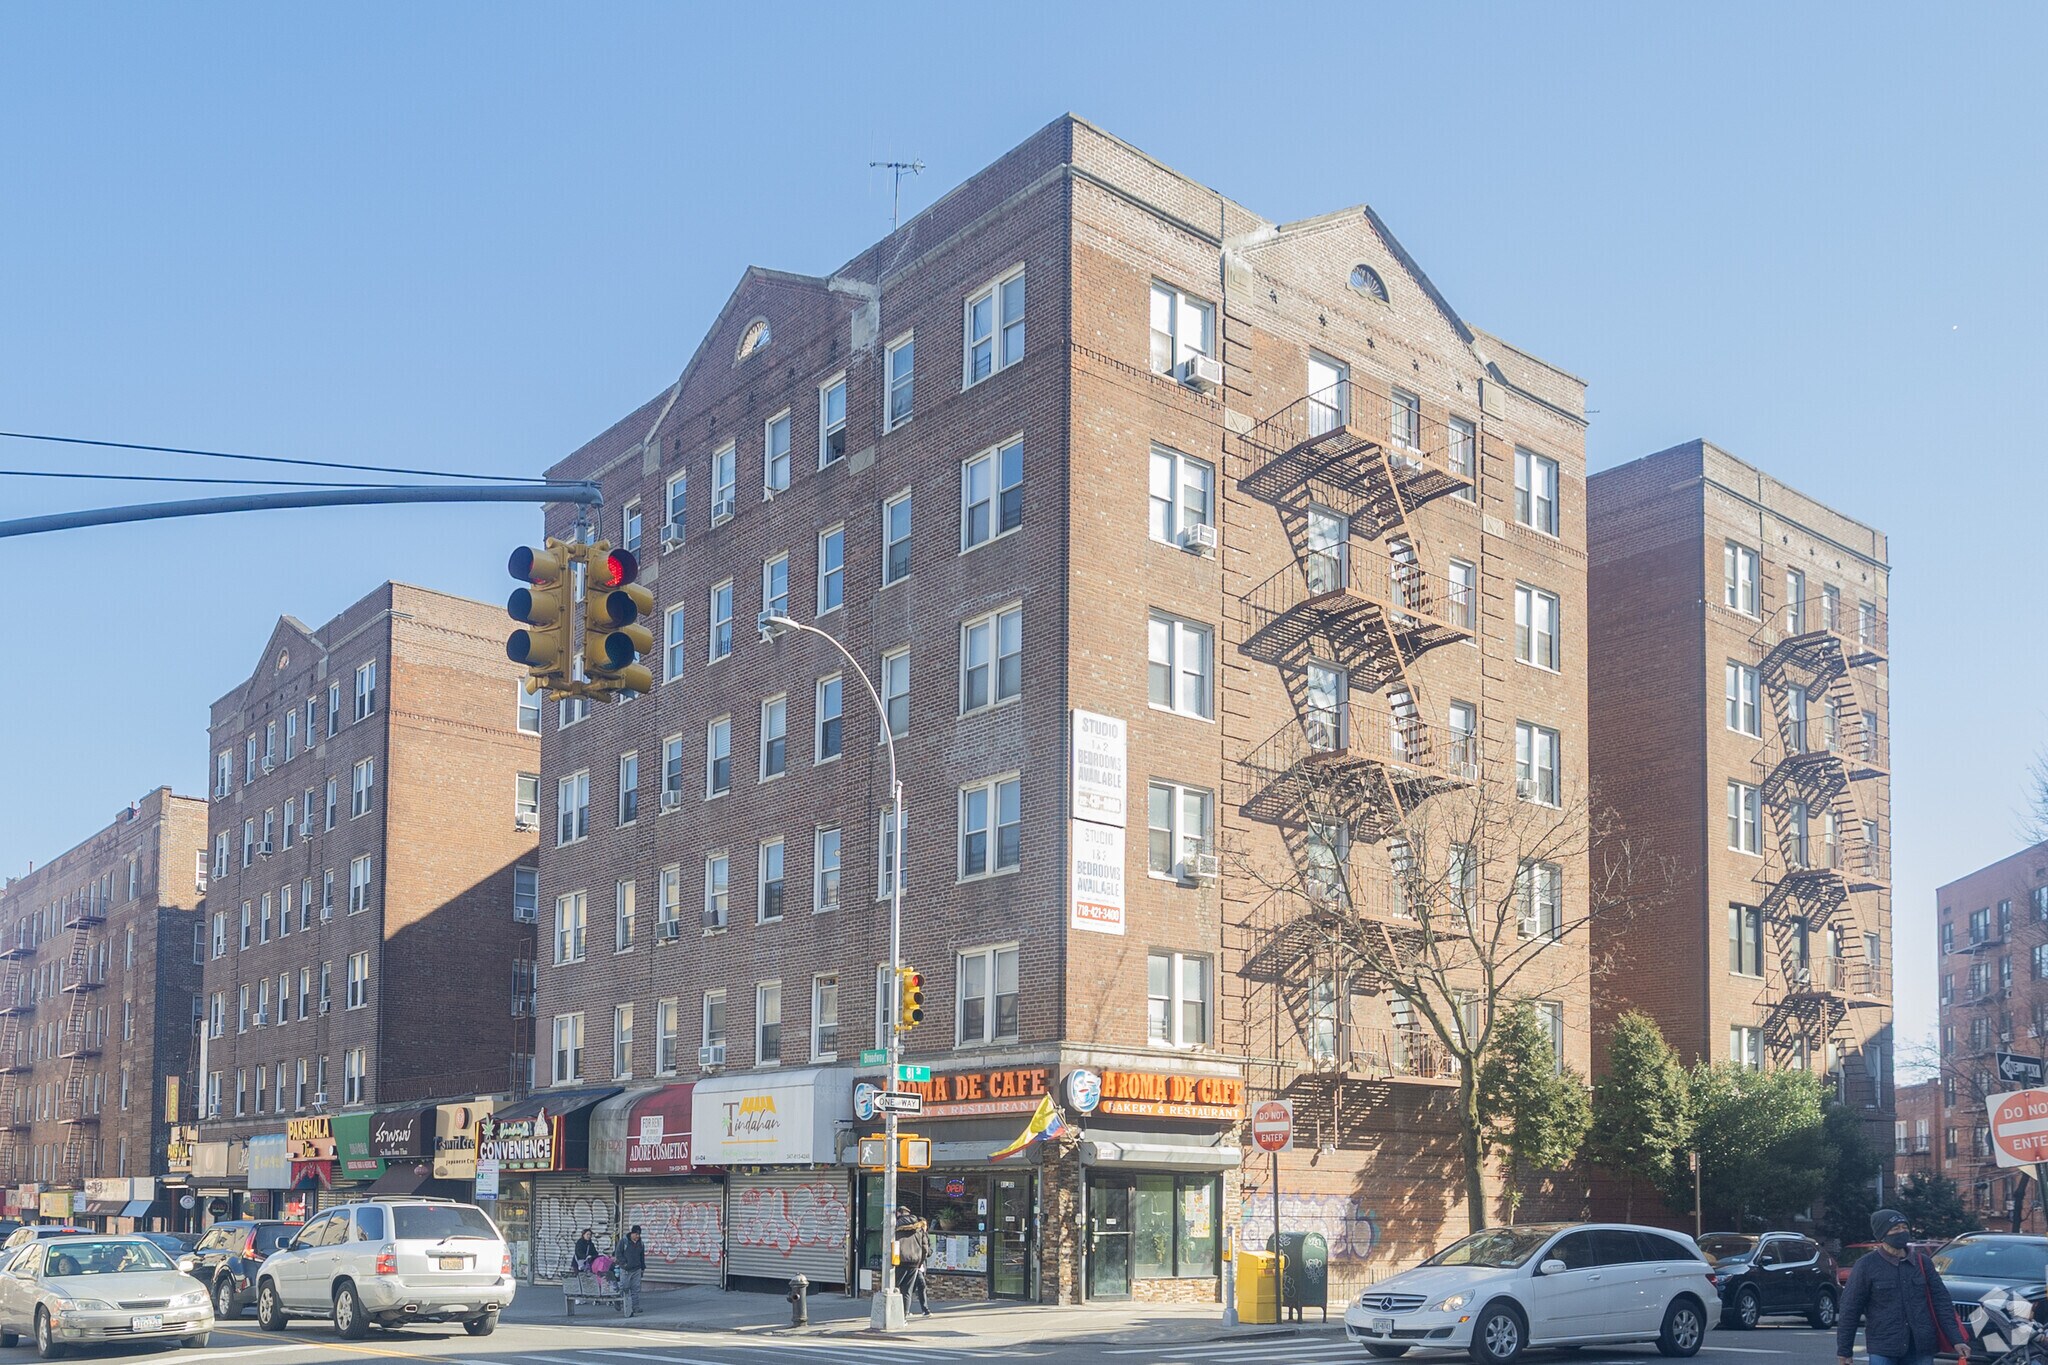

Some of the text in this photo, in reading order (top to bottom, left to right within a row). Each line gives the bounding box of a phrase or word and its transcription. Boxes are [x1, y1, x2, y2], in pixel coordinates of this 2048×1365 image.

[1082, 717, 1119, 739] STUDIO
[1078, 748, 1121, 771] BEDROOMS
[1078, 766, 1122, 788] AVAILABLE
[1085, 828, 1114, 846] STUDIO
[1077, 860, 1121, 881] BEDROOMS
[1077, 877, 1119, 897] AVAILABLE
[864, 1052, 885, 1064] Broadway
[906, 1067, 914, 1079] 81
[2005, 1062, 2018, 1074] ONE
[956, 1074, 981, 1101] DE
[989, 1068, 1046, 1098] CAFE
[1104, 1071, 1243, 1105] AROMA DE CAFE
[879, 1097, 917, 1107] ONE WAY
[937, 1107, 945, 1116] &
[951, 1101, 1039, 1116] RESTAURANT
[1109, 1101, 1241, 1118] BAKERY & RESTAURANT
[2003, 1102, 2048, 1120] DO NO
[642, 1116, 662, 1128] FOR RENT
[722, 1101, 781, 1137] Tindahan
[1259, 1111, 1285, 1120] DO NOT
[288, 1118, 330, 1140] PAKSHALA
[1261, 1133, 1284, 1142] ENTER
[480, 1137, 551, 1160] CONVENIENCE
[629, 1141, 689, 1161] ADORE COSMETICS
[2013, 1135, 2048, 1151] ENTE
[946, 1184, 964, 1193] OPEN
[979, 1201, 986, 1210] A
